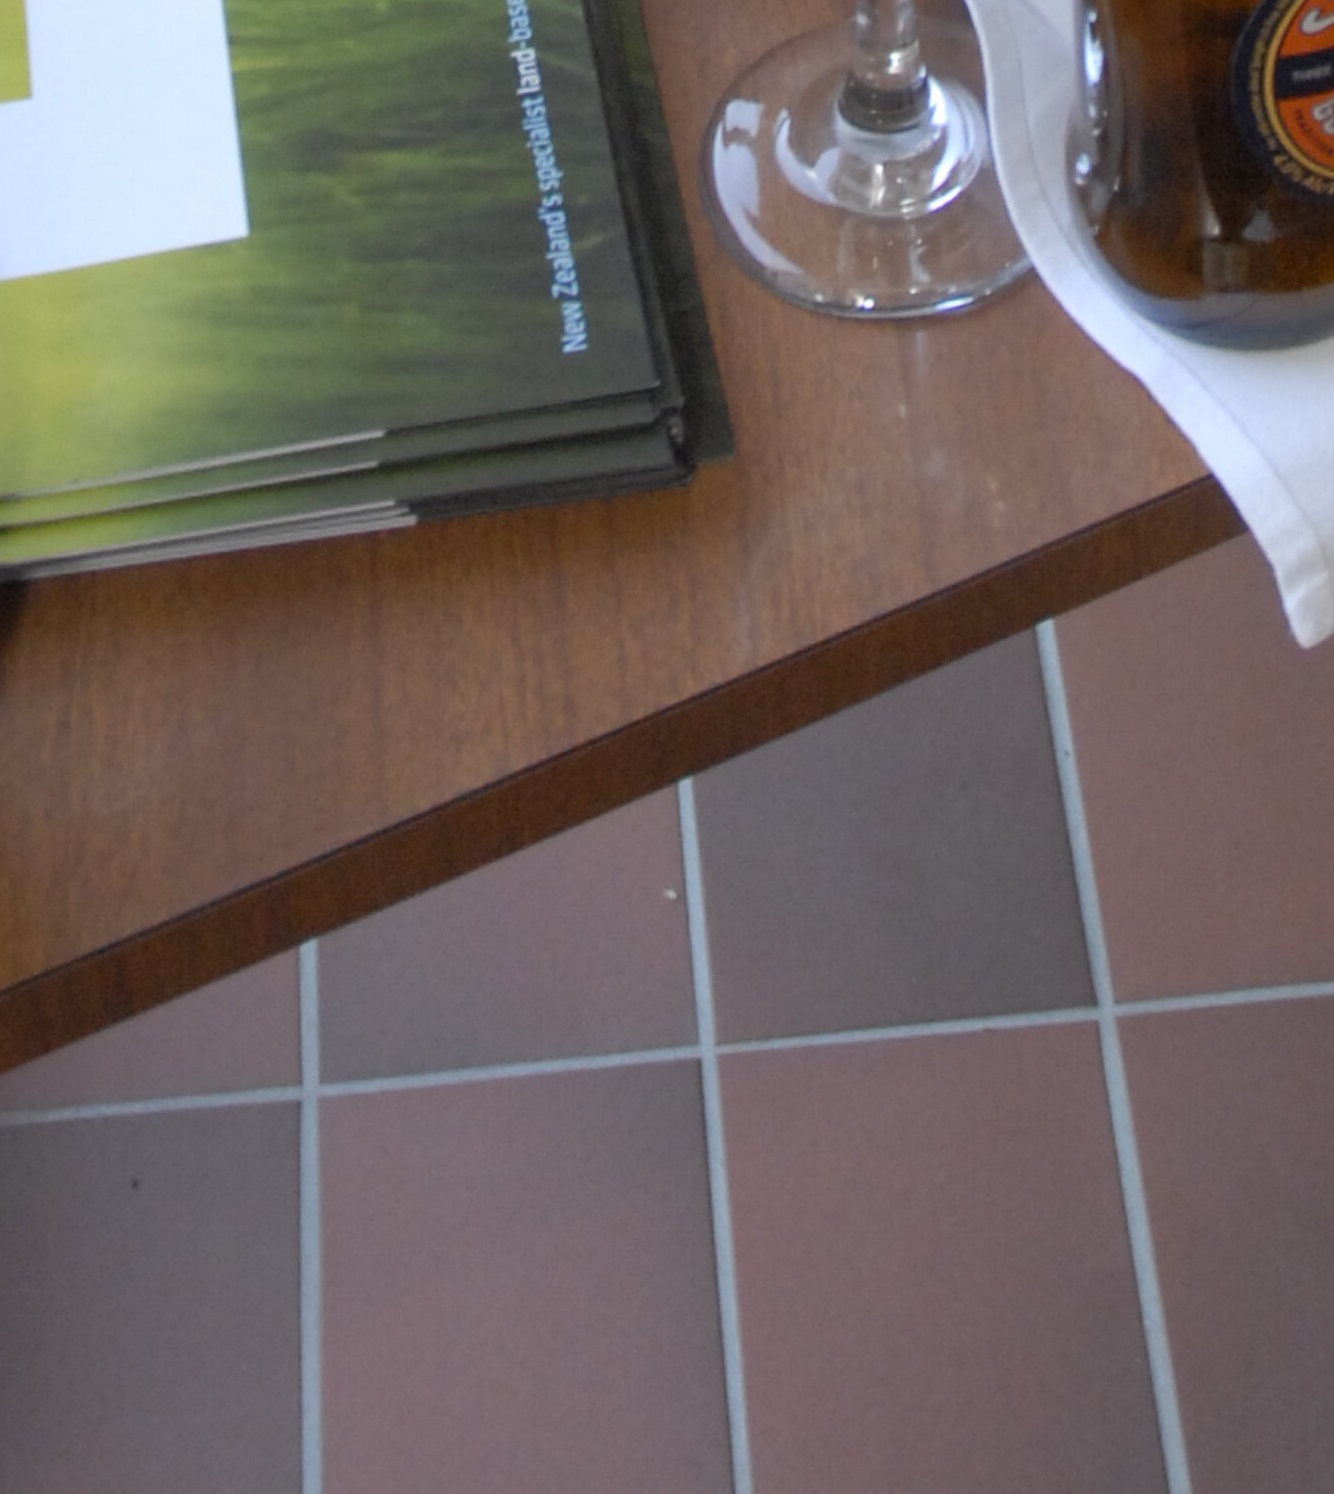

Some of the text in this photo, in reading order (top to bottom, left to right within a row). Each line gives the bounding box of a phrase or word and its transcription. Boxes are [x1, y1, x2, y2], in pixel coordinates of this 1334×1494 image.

[522, 95, 564, 192] specialist
[538, 192, 580, 299] Zealand's
[560, 300, 589, 354] New
